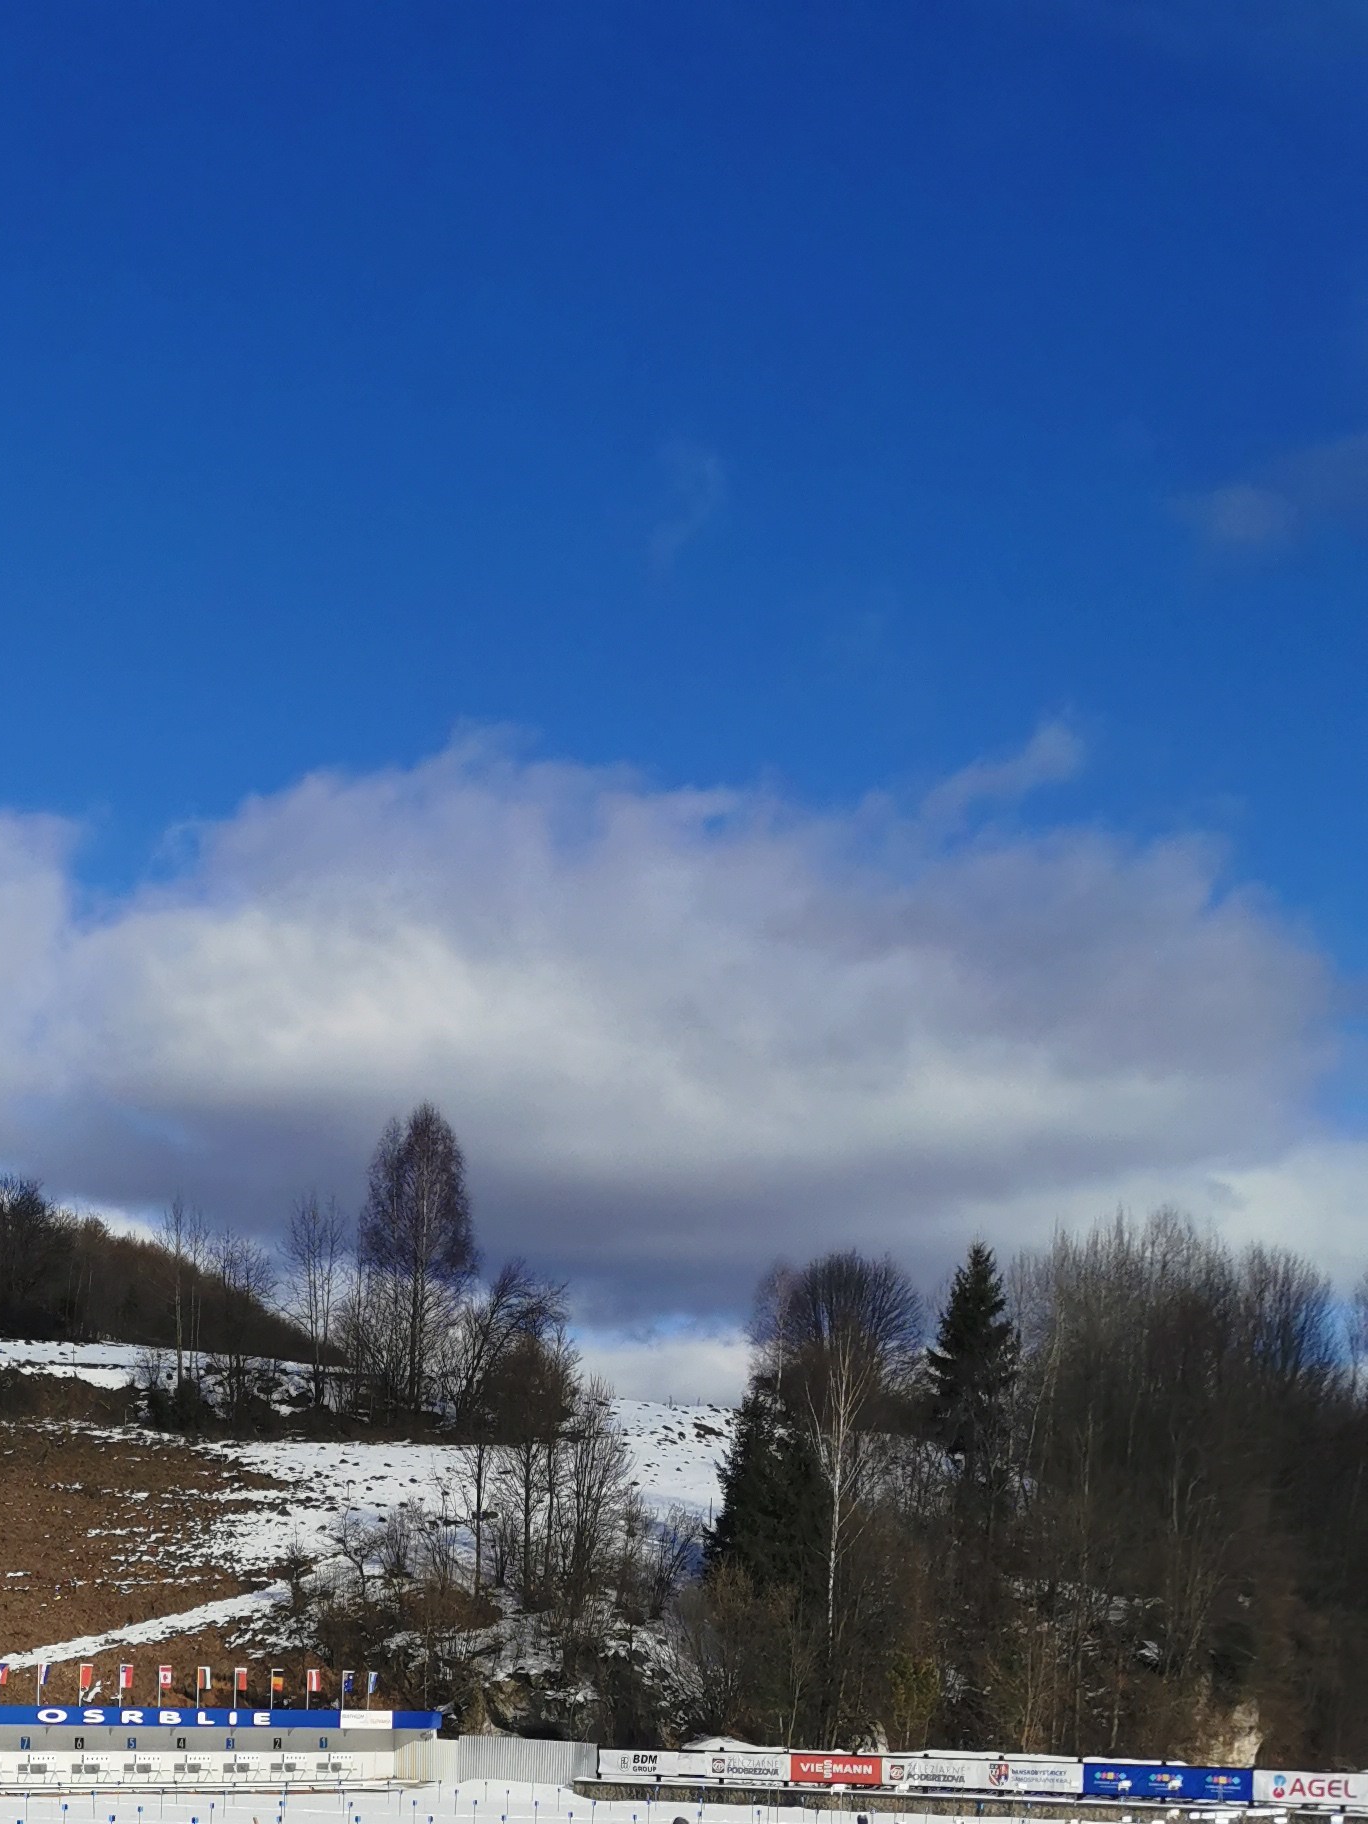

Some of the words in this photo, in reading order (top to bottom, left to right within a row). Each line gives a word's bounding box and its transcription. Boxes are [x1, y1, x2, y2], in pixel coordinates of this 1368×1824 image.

[37, 1709, 272, 1726] OSRBLIE
[21, 1737, 29, 1748] 7
[76, 1738, 83, 1748] 6
[128, 1738, 134, 1748] 5
[274, 1738, 280, 1748] 2
[321, 1737, 326, 1748] 1
[633, 1754, 658, 1764] BDM
[1289, 1778, 1357, 1799] AGEL
